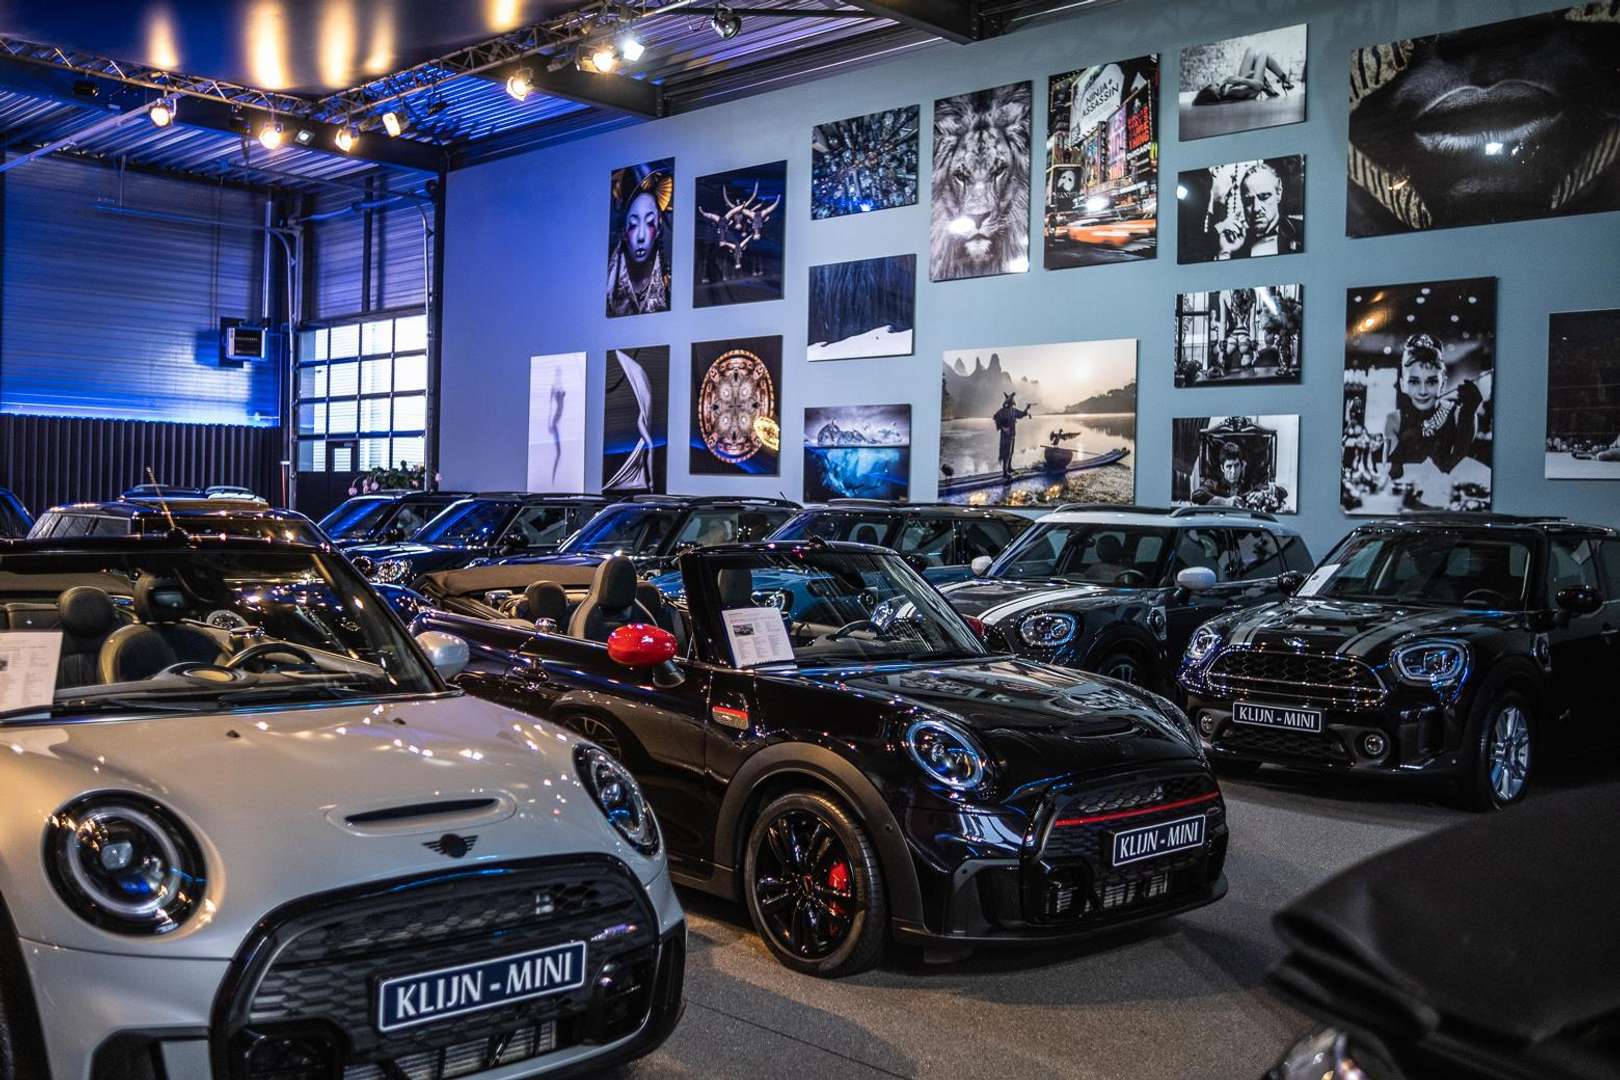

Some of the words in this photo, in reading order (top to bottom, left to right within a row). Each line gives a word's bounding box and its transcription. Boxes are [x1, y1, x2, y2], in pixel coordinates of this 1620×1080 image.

[1086, 82, 1108, 103] NINJA
[1239, 706, 1274, 723] KLIJN
[1283, 711, 1315, 728] MINI
[1120, 830, 1159, 859] KLIJN
[1167, 821, 1199, 848] MINI
[396, 970, 483, 1019] KLIJN
[506, 952, 572, 995] MINI
